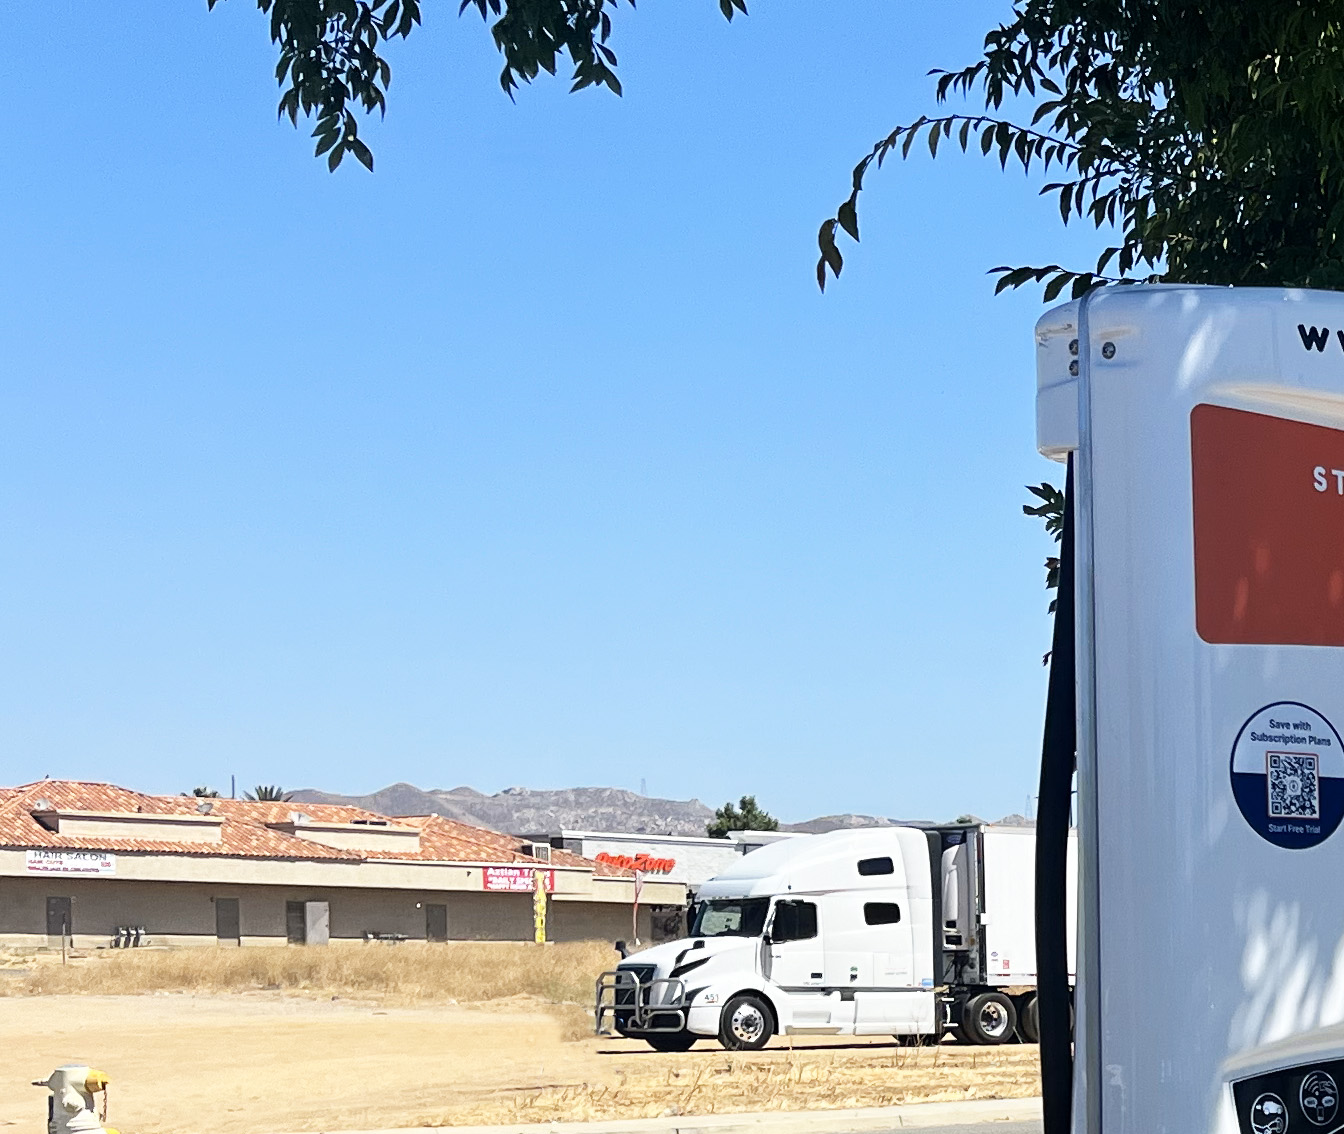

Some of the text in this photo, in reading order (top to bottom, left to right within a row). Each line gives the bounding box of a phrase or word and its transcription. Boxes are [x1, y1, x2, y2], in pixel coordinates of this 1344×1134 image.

[1269, 719, 1312, 732] Save with
[1250, 732, 1332, 747] Subscription Plans
[1268, 823, 1321, 834] Start Free Trial
